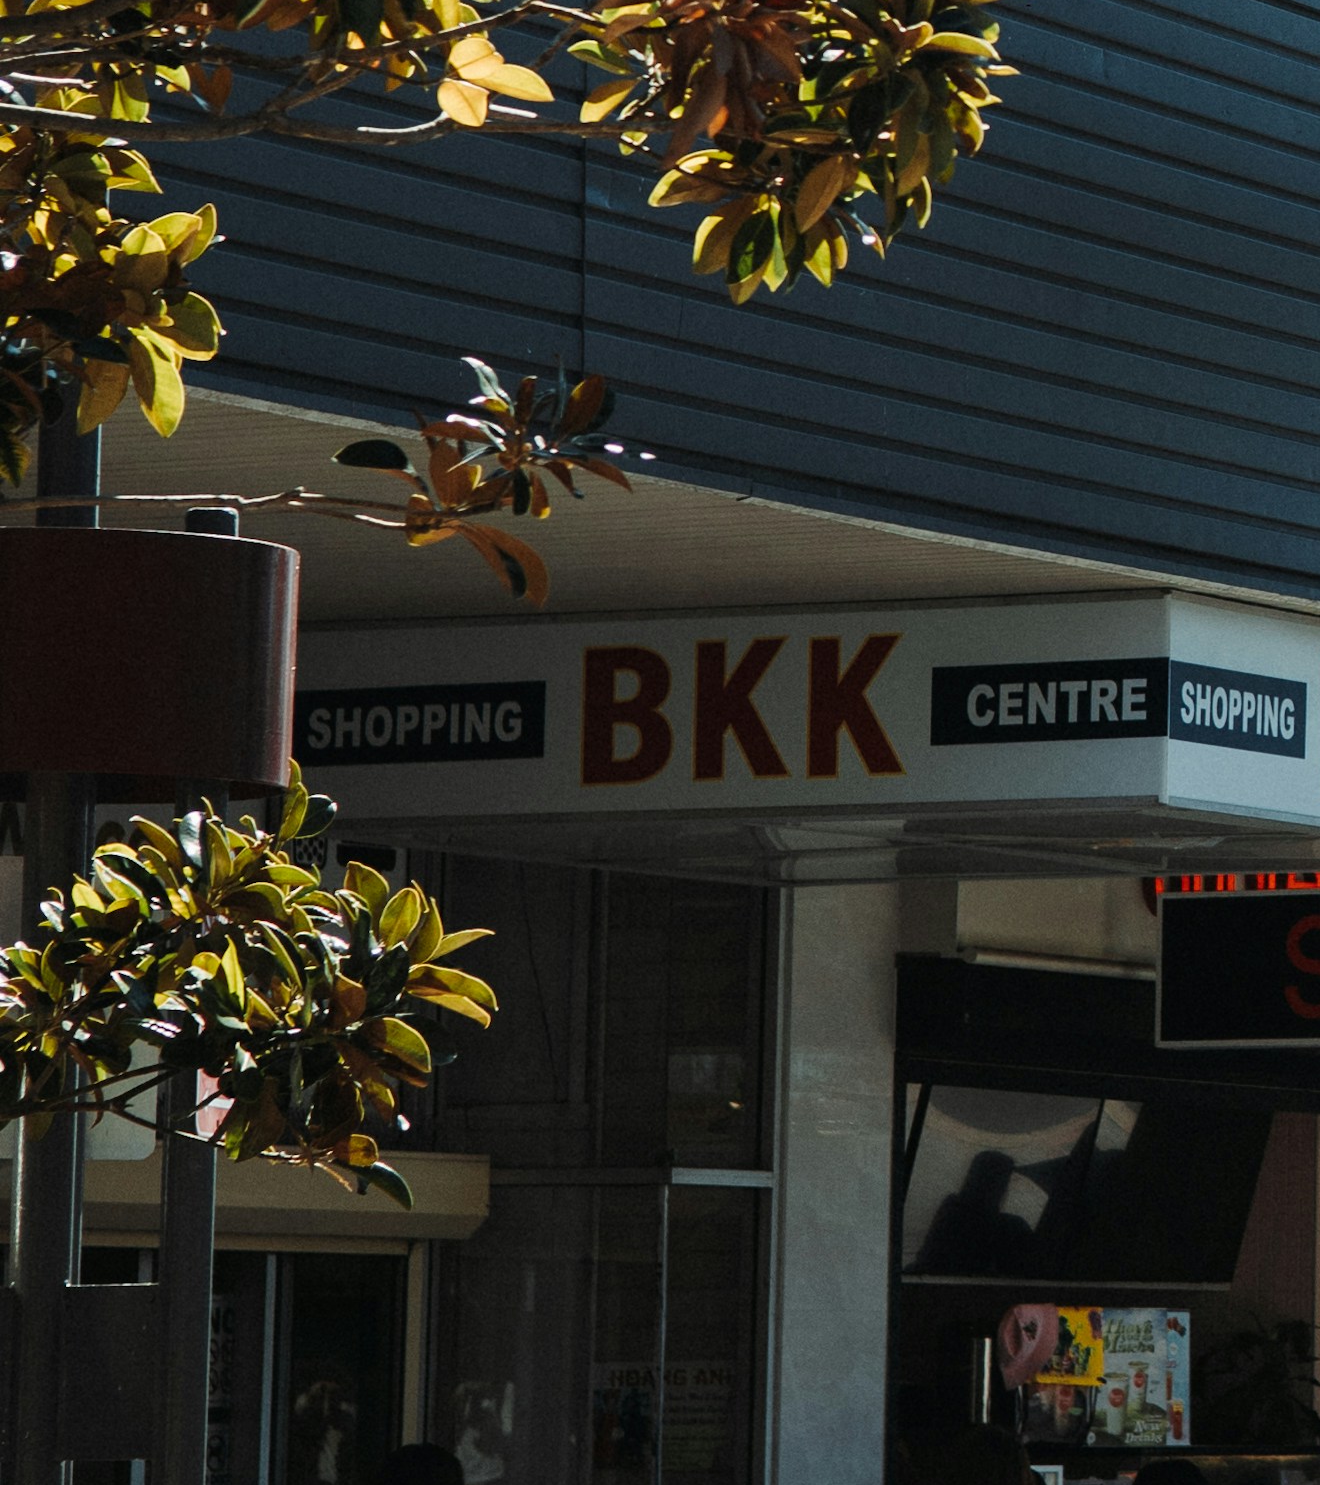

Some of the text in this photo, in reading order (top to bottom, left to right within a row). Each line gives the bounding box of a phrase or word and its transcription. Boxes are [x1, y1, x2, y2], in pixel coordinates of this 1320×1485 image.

[307, 631, 1148, 787] SHOPPING BKK CENTRE
[1180, 681, 1296, 740] SHOPPING
